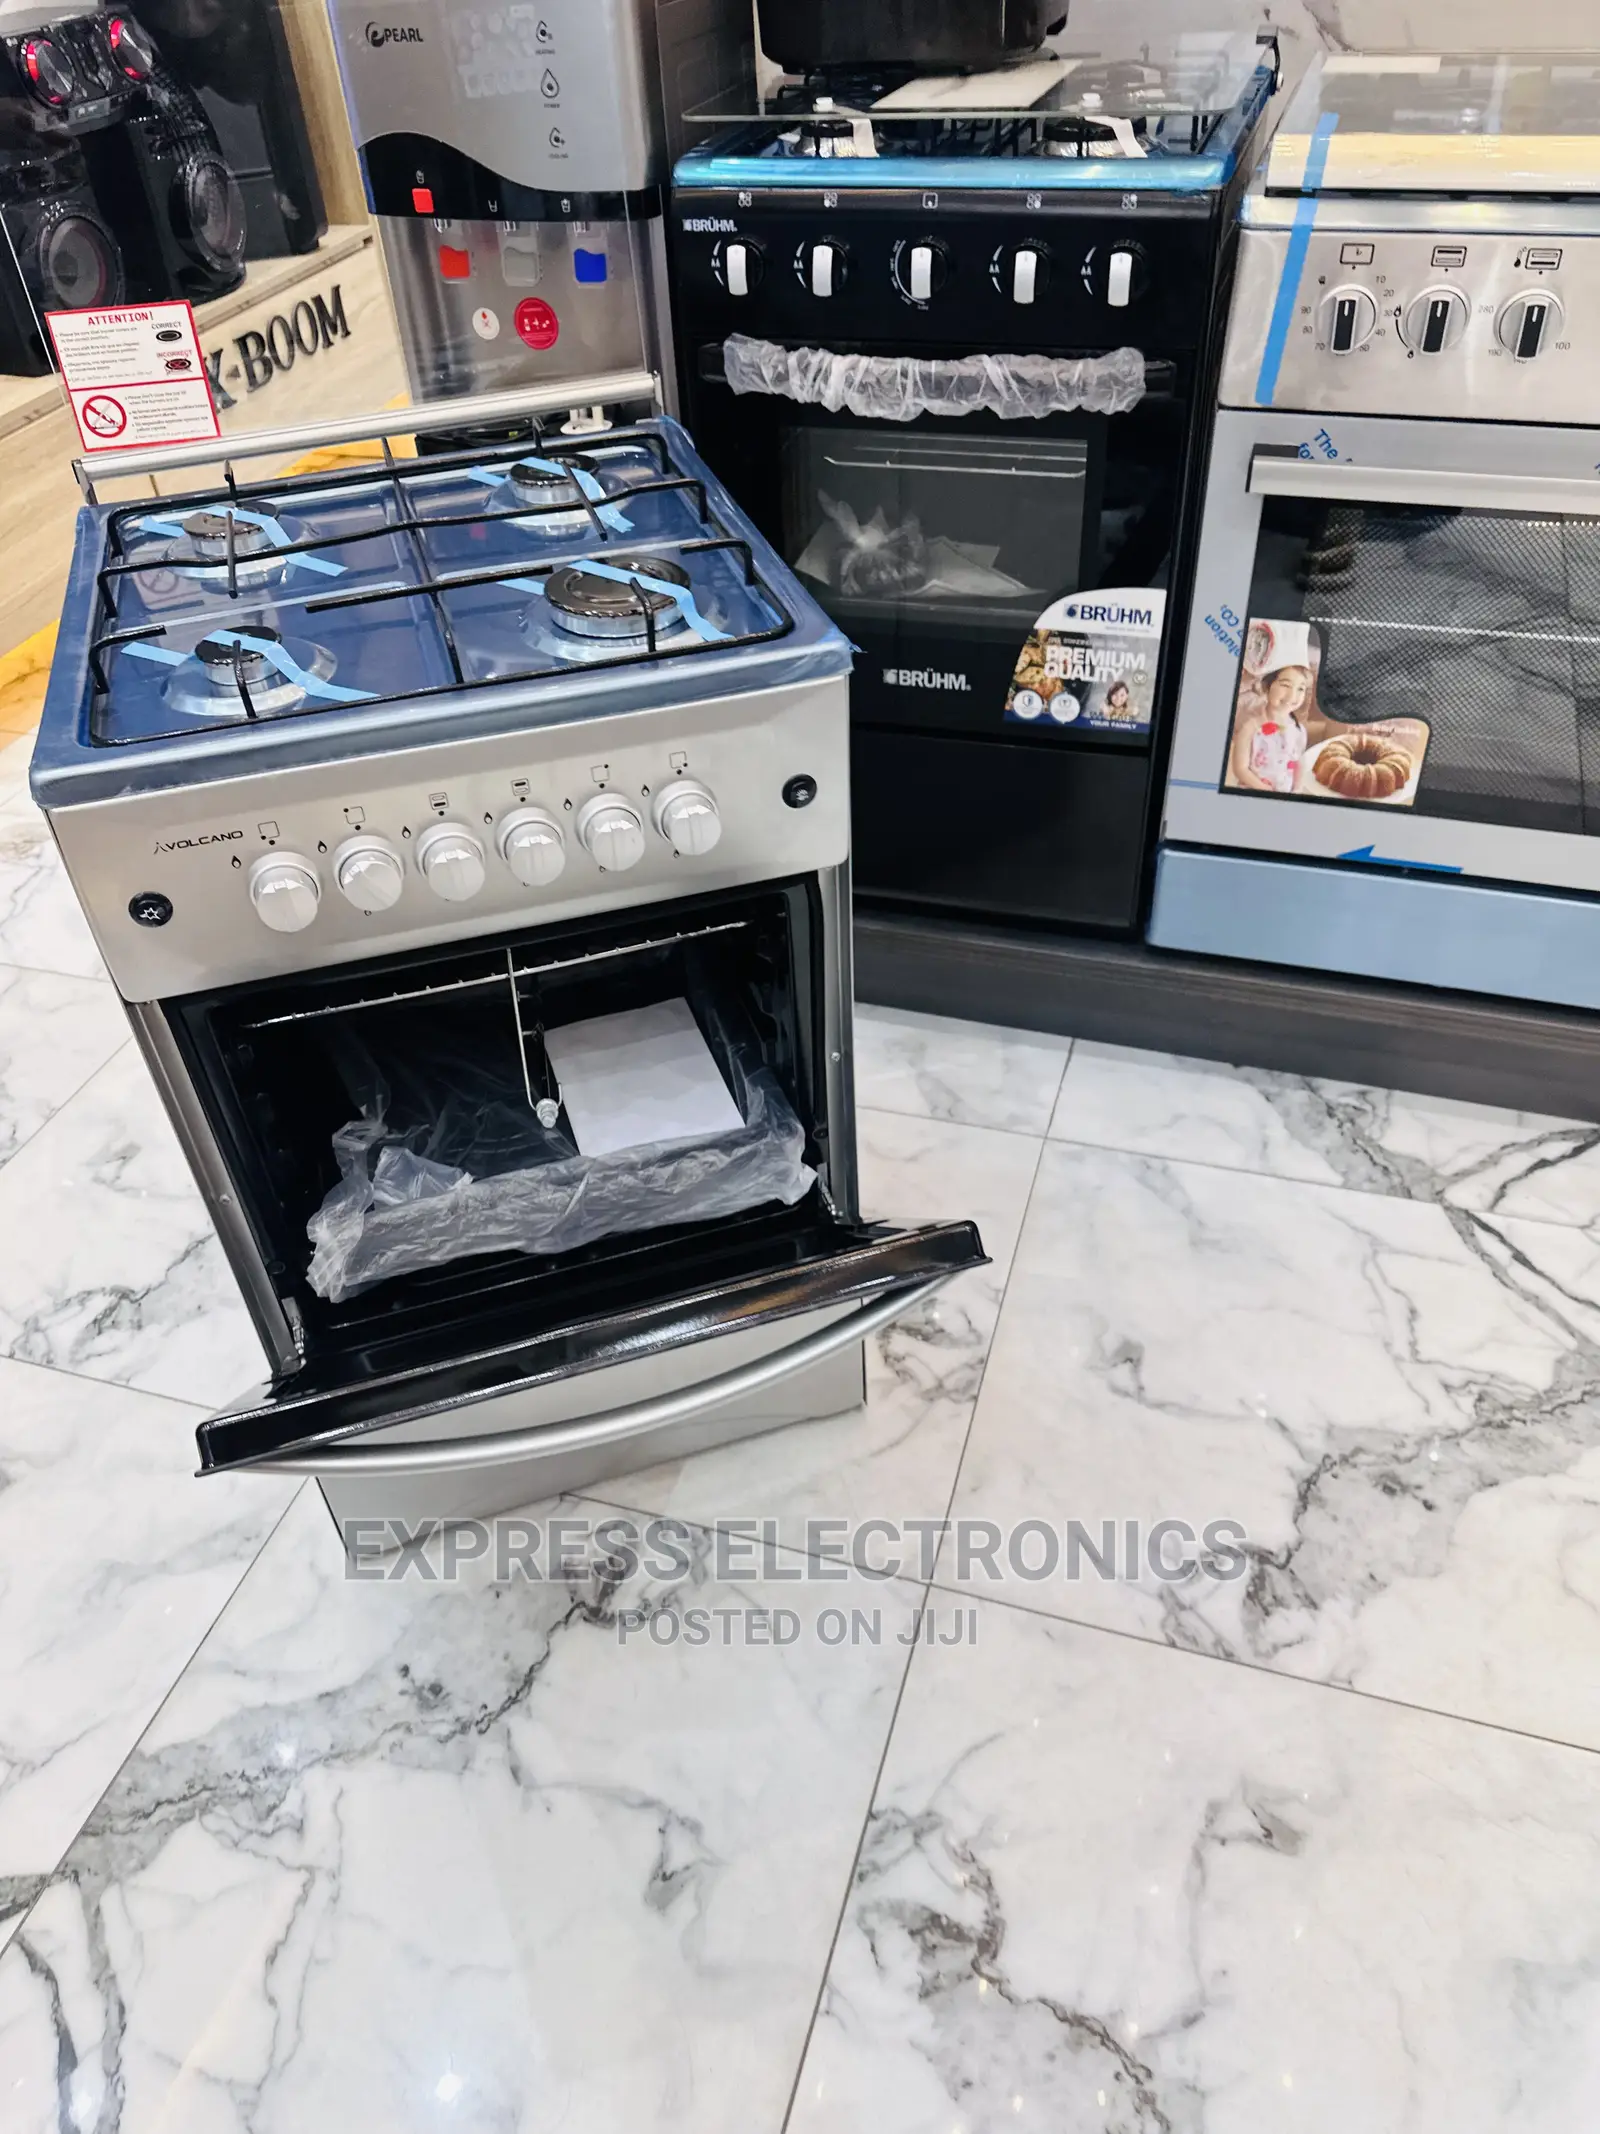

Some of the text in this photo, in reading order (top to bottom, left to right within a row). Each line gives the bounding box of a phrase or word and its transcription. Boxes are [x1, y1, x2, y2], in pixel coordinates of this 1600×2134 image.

[384, 26, 424, 43] PEARL
[1375, 275, 1387, 284] 10
[1383, 289, 1395, 298] 20
[151, 320, 182, 330] CORRECT
[1375, 327, 1386, 337] 40
[1554, 341, 1571, 351] 100
[1313, 428, 1339, 460] The
[1079, 603, 1153, 626] BRÜHM
[1045, 644, 1146, 670] PREMIUM
[898, 667, 971, 691] BRÜHM
[1043, 661, 1125, 683] QUALITY
[165, 830, 244, 850] VOLCANO
